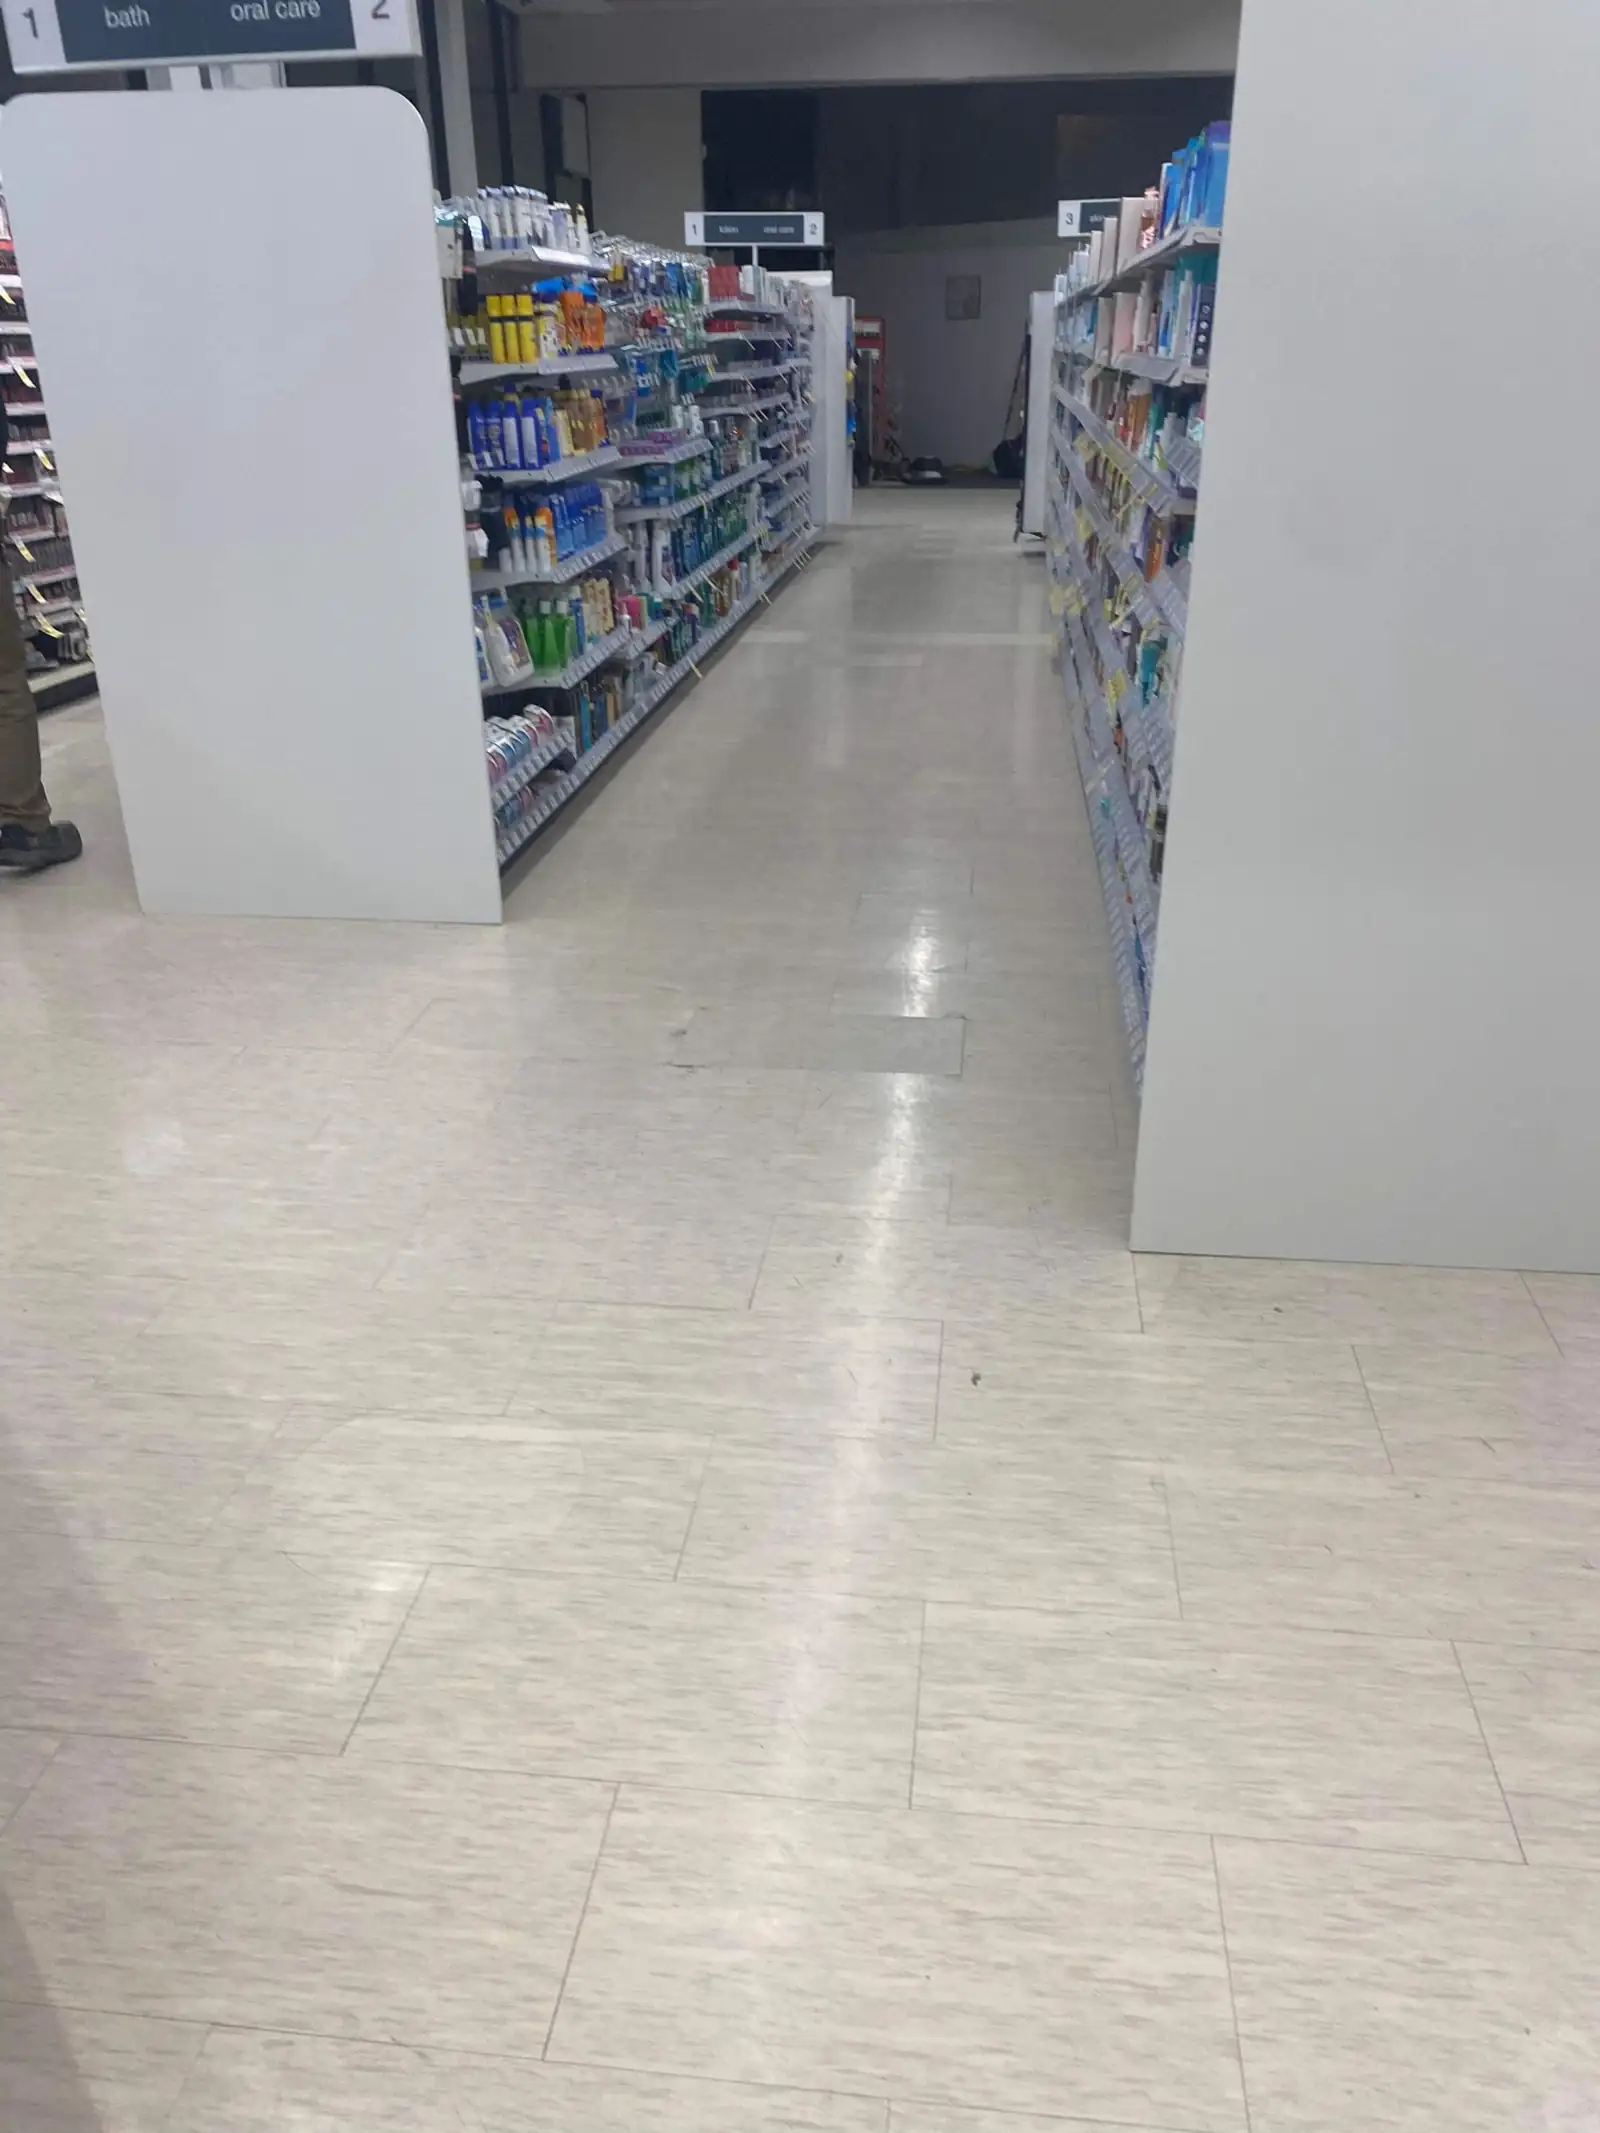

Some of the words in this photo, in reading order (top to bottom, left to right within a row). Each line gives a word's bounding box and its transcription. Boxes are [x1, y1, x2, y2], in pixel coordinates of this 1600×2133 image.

[103, 4, 151, 29] bath
[230, 0, 270, 21] oral
[275, 0, 321, 19] care
[20, 7, 39, 39] 1
[1065, 212, 1074, 226] 3
